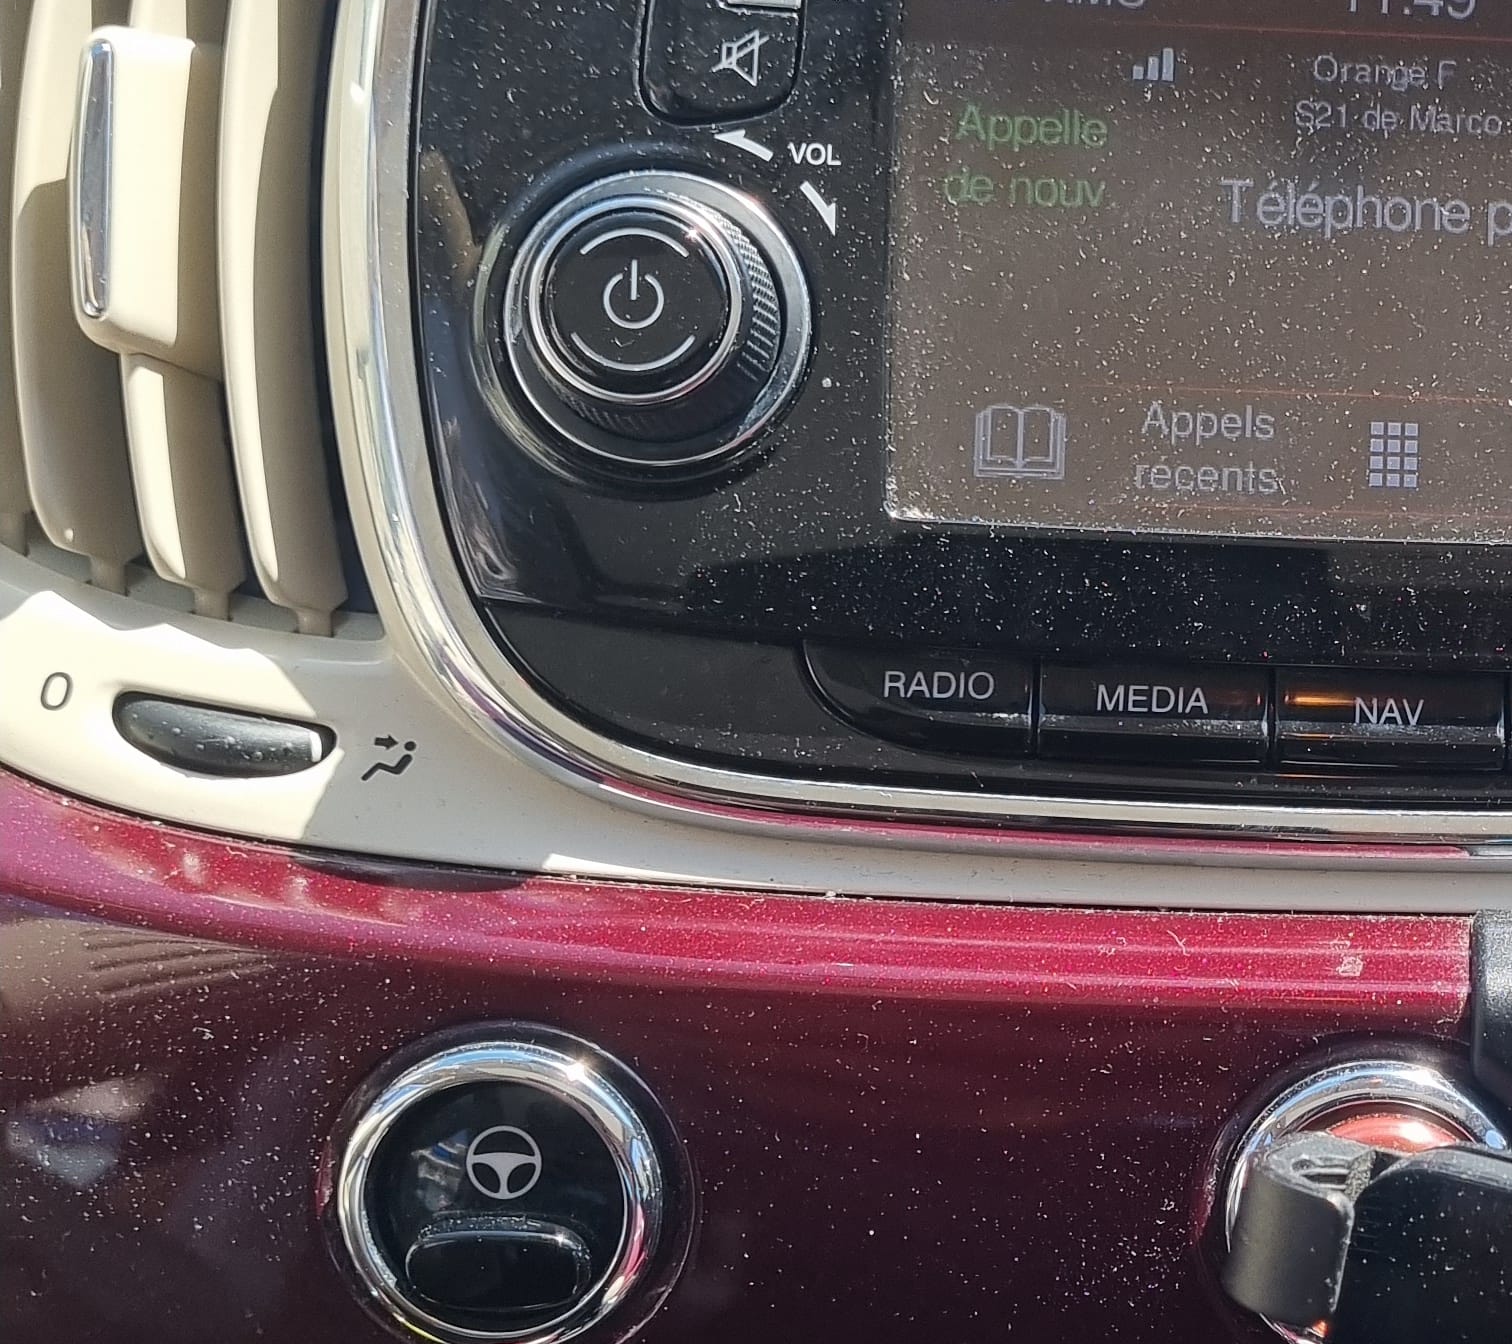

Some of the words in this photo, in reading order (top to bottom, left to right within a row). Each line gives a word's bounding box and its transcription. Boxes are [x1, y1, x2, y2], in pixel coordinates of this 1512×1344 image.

[1312, 54, 1427, 92] Orange
[1436, 59, 1457, 89] F
[955, 105, 1108, 151] Appelle
[1295, 100, 1348, 129] S21
[1363, 104, 1398, 130] de
[1409, 105, 1502, 136] Marco
[788, 142, 842, 167] VOL
[942, 167, 994, 204] de
[1219, 177, 1471, 240] Téléphone
[1141, 401, 1276, 447] Appels
[883, 670, 995, 701] RADIO
[1096, 684, 1209, 715] MEDIA
[1354, 696, 1425, 726] NAV
